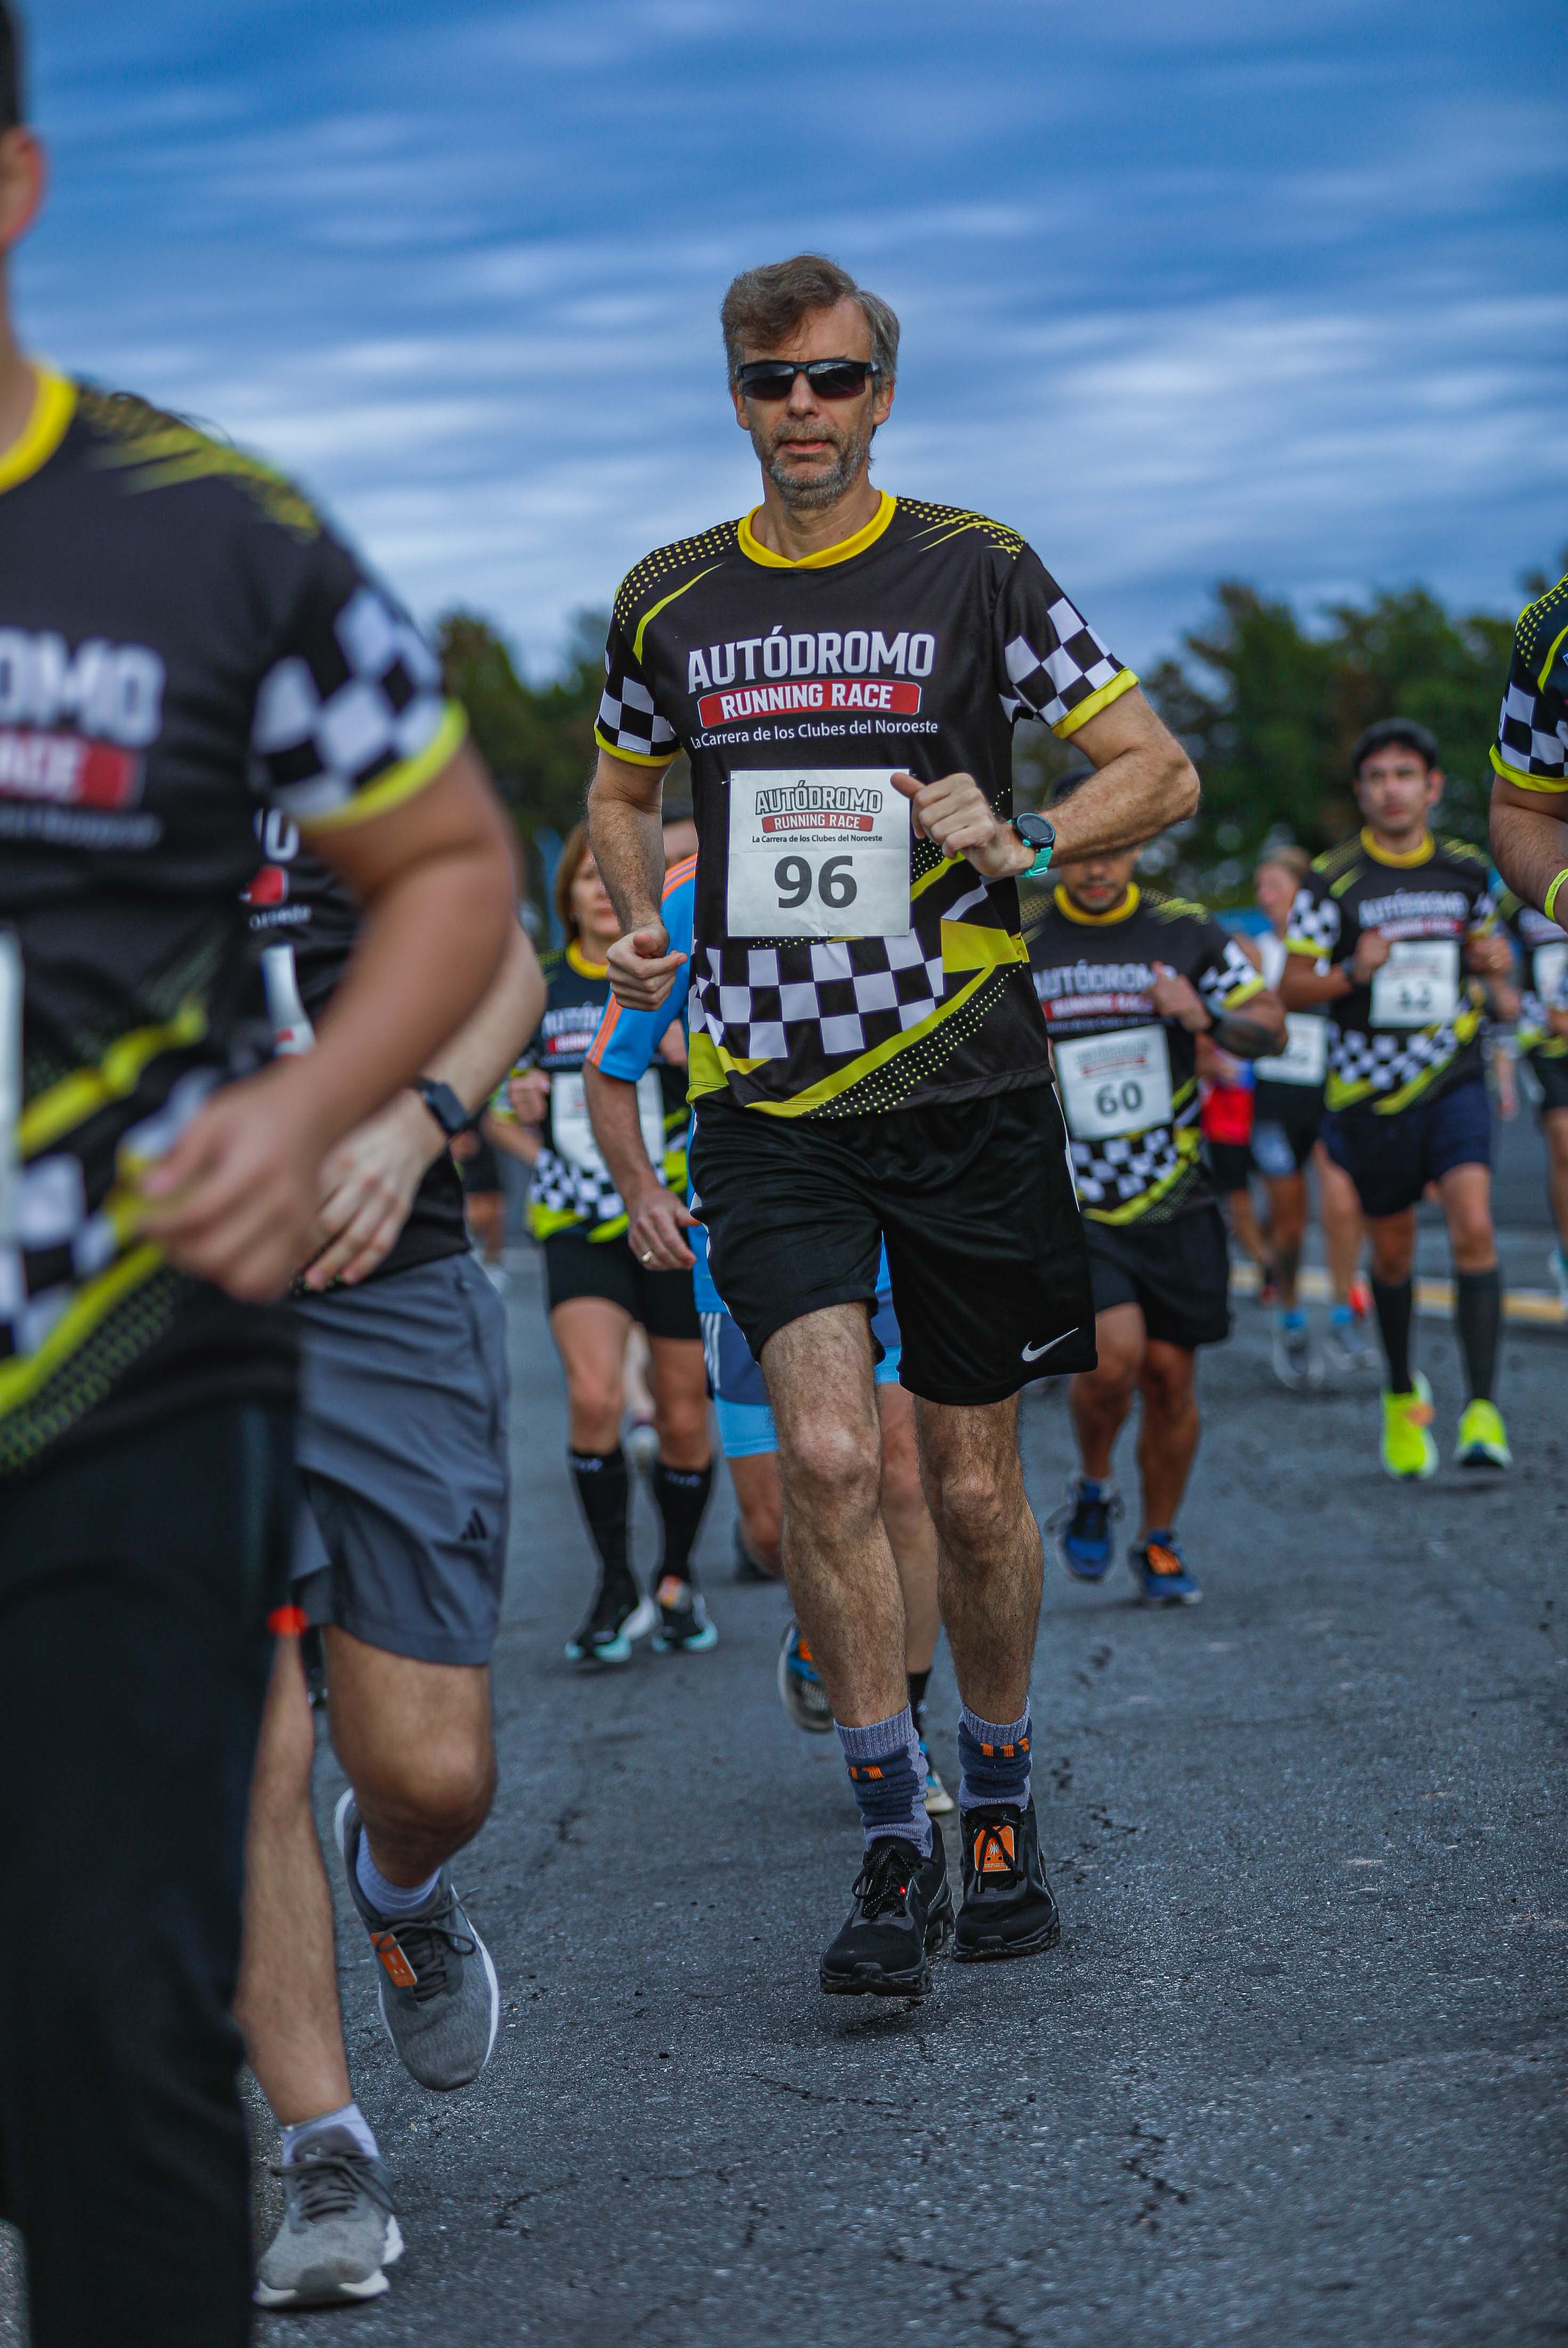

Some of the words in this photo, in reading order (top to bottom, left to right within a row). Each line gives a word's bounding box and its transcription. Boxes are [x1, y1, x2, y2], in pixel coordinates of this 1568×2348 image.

[688, 625, 935, 694] AUTÓDROMO
[720, 684, 823, 719] RUNNING
[831, 683, 893, 709] RACE
[690, 736, 701, 749] La
[701, 730, 749, 746] Carrera
[753, 727, 770, 741] de
[774, 726, 795, 740] los
[798, 722, 846, 737] Clubes
[849, 720, 871, 734] del
[875, 720, 938, 734] Noroeste
[755, 780, 882, 815] AUTÓDROMO
[774, 814, 825, 830] RUNNING
[829, 814, 860, 829] RACE
[811, 834, 836, 842] Clubes
[838, 834, 849, 842] del
[774, 855, 857, 908] 96
[1096, 1081, 1143, 1117] 60
